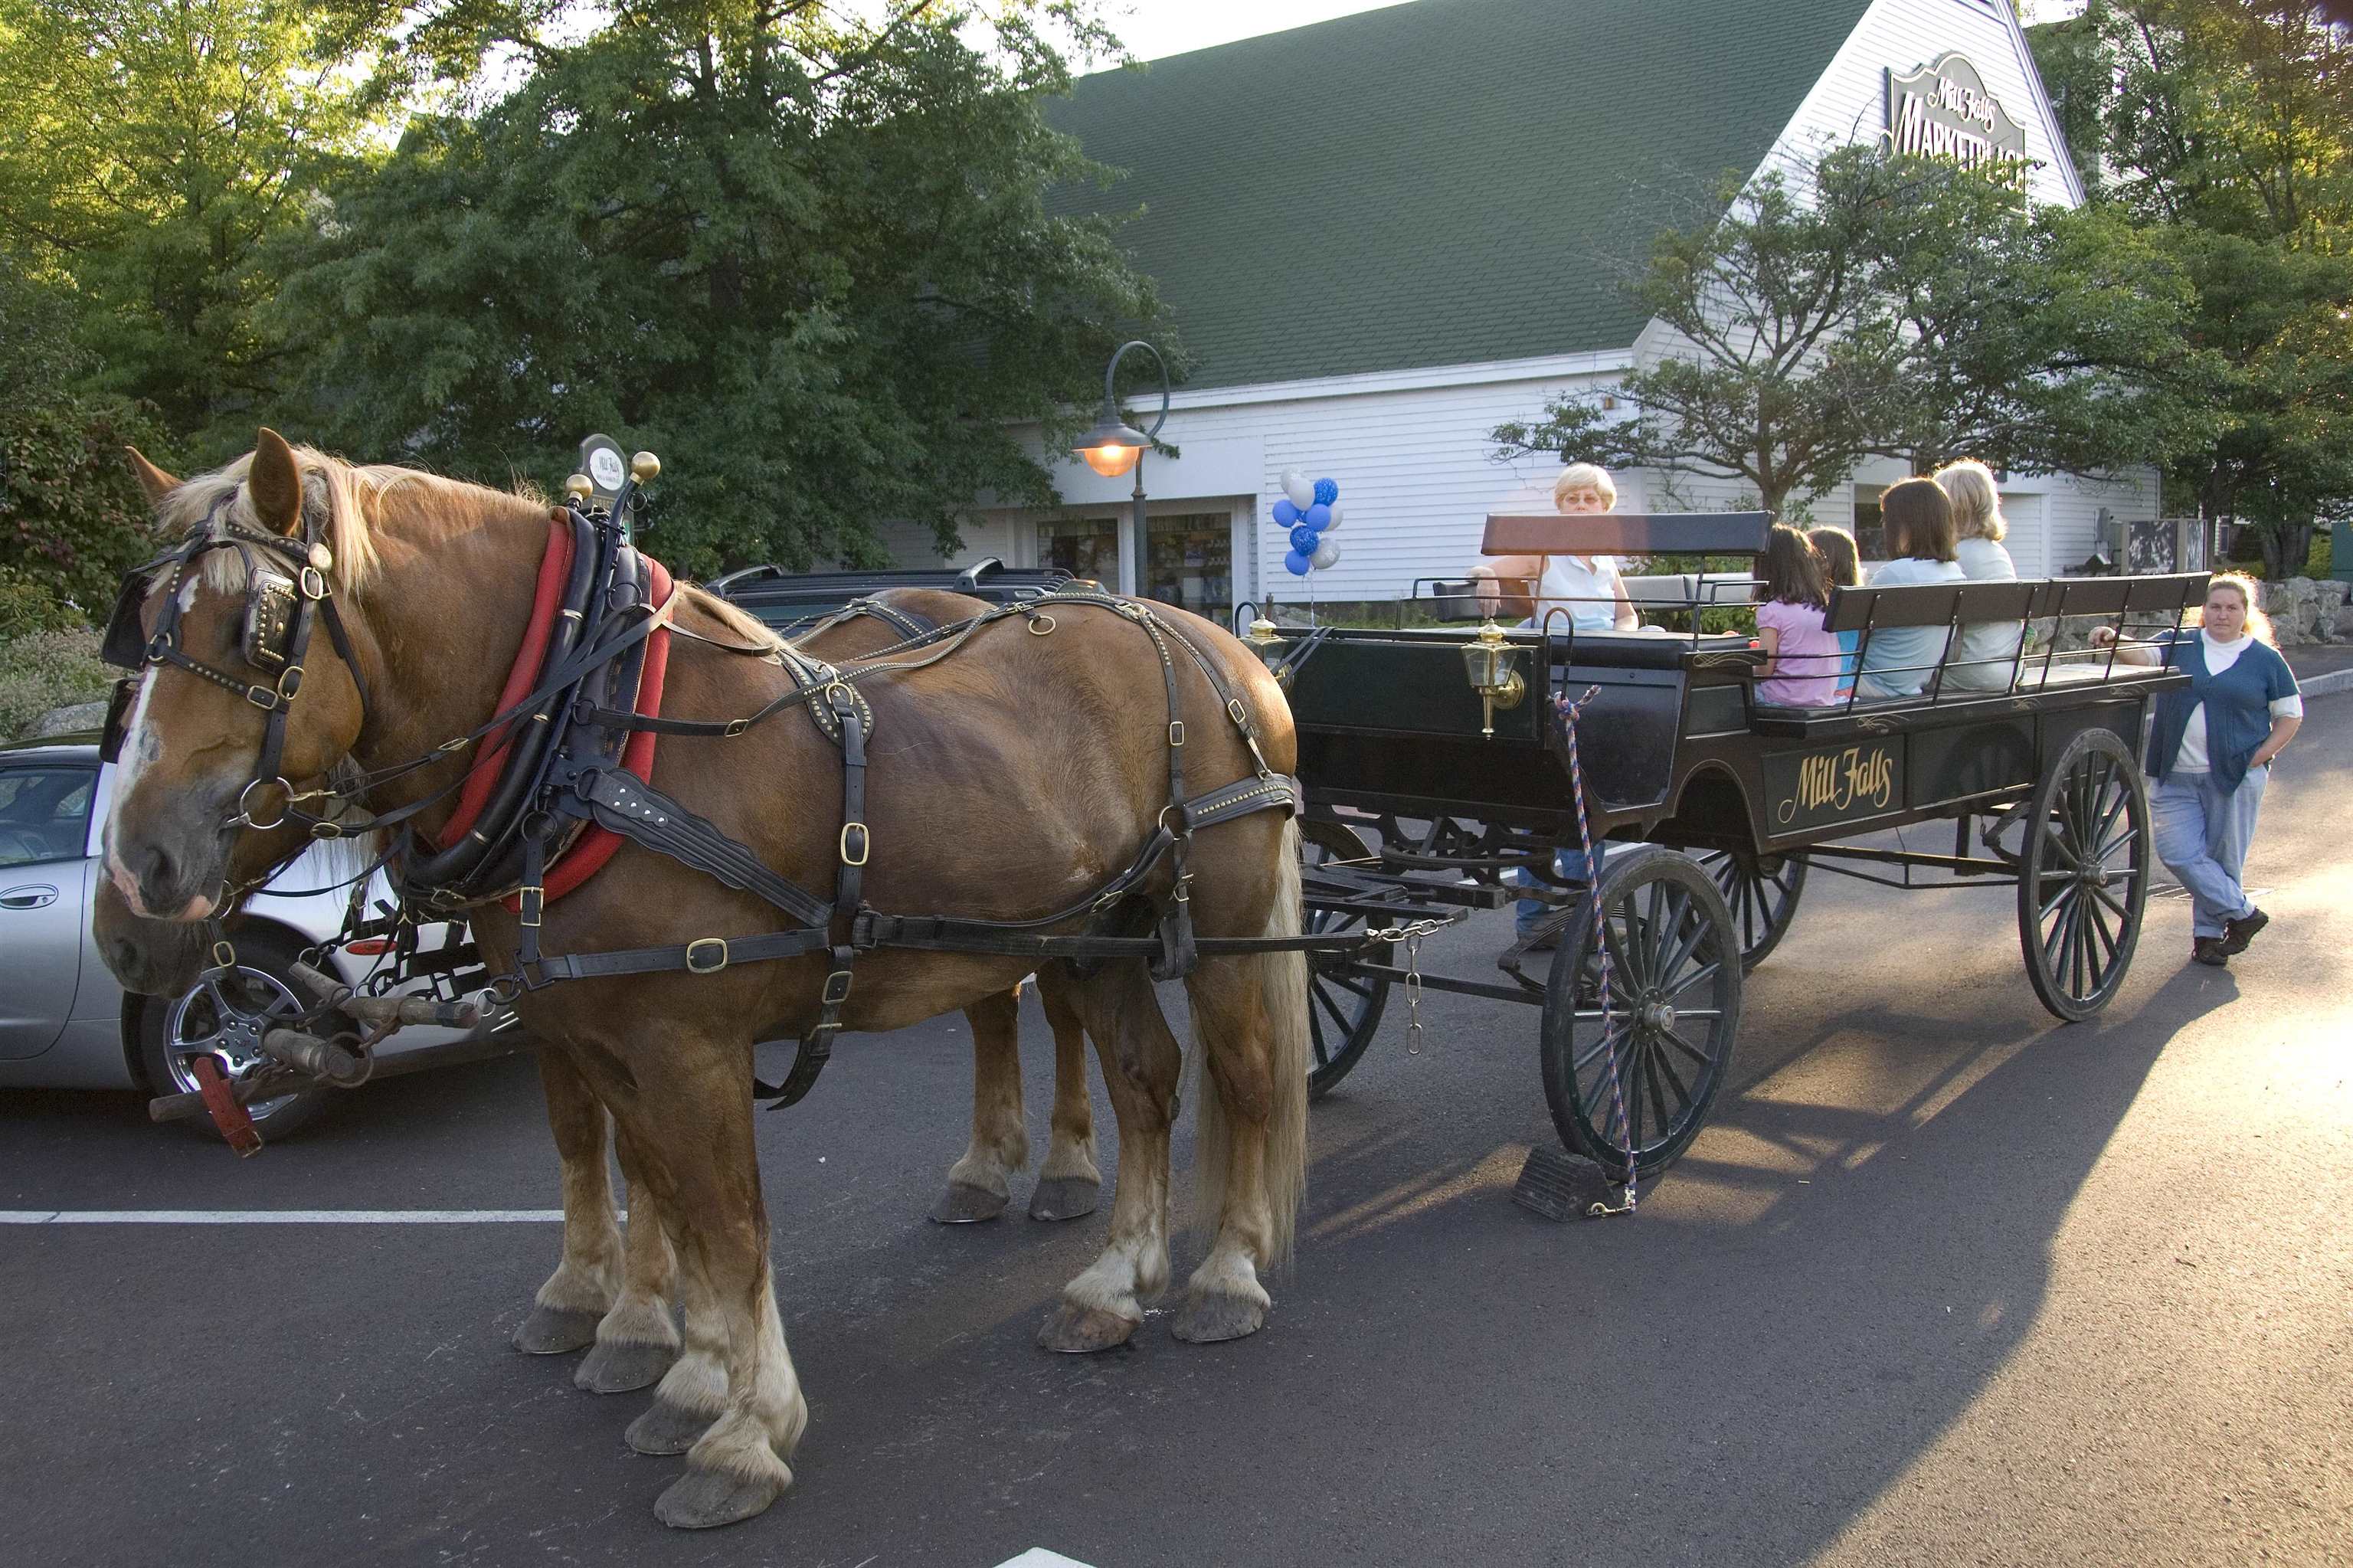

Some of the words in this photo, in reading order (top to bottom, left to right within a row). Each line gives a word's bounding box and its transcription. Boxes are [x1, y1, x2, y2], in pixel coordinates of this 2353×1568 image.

[1926, 77, 1966, 112] Mill
[1958, 88, 1995, 133] Falls
[1778, 755, 1842, 823] Mill
[1834, 747, 1892, 810] Falls
